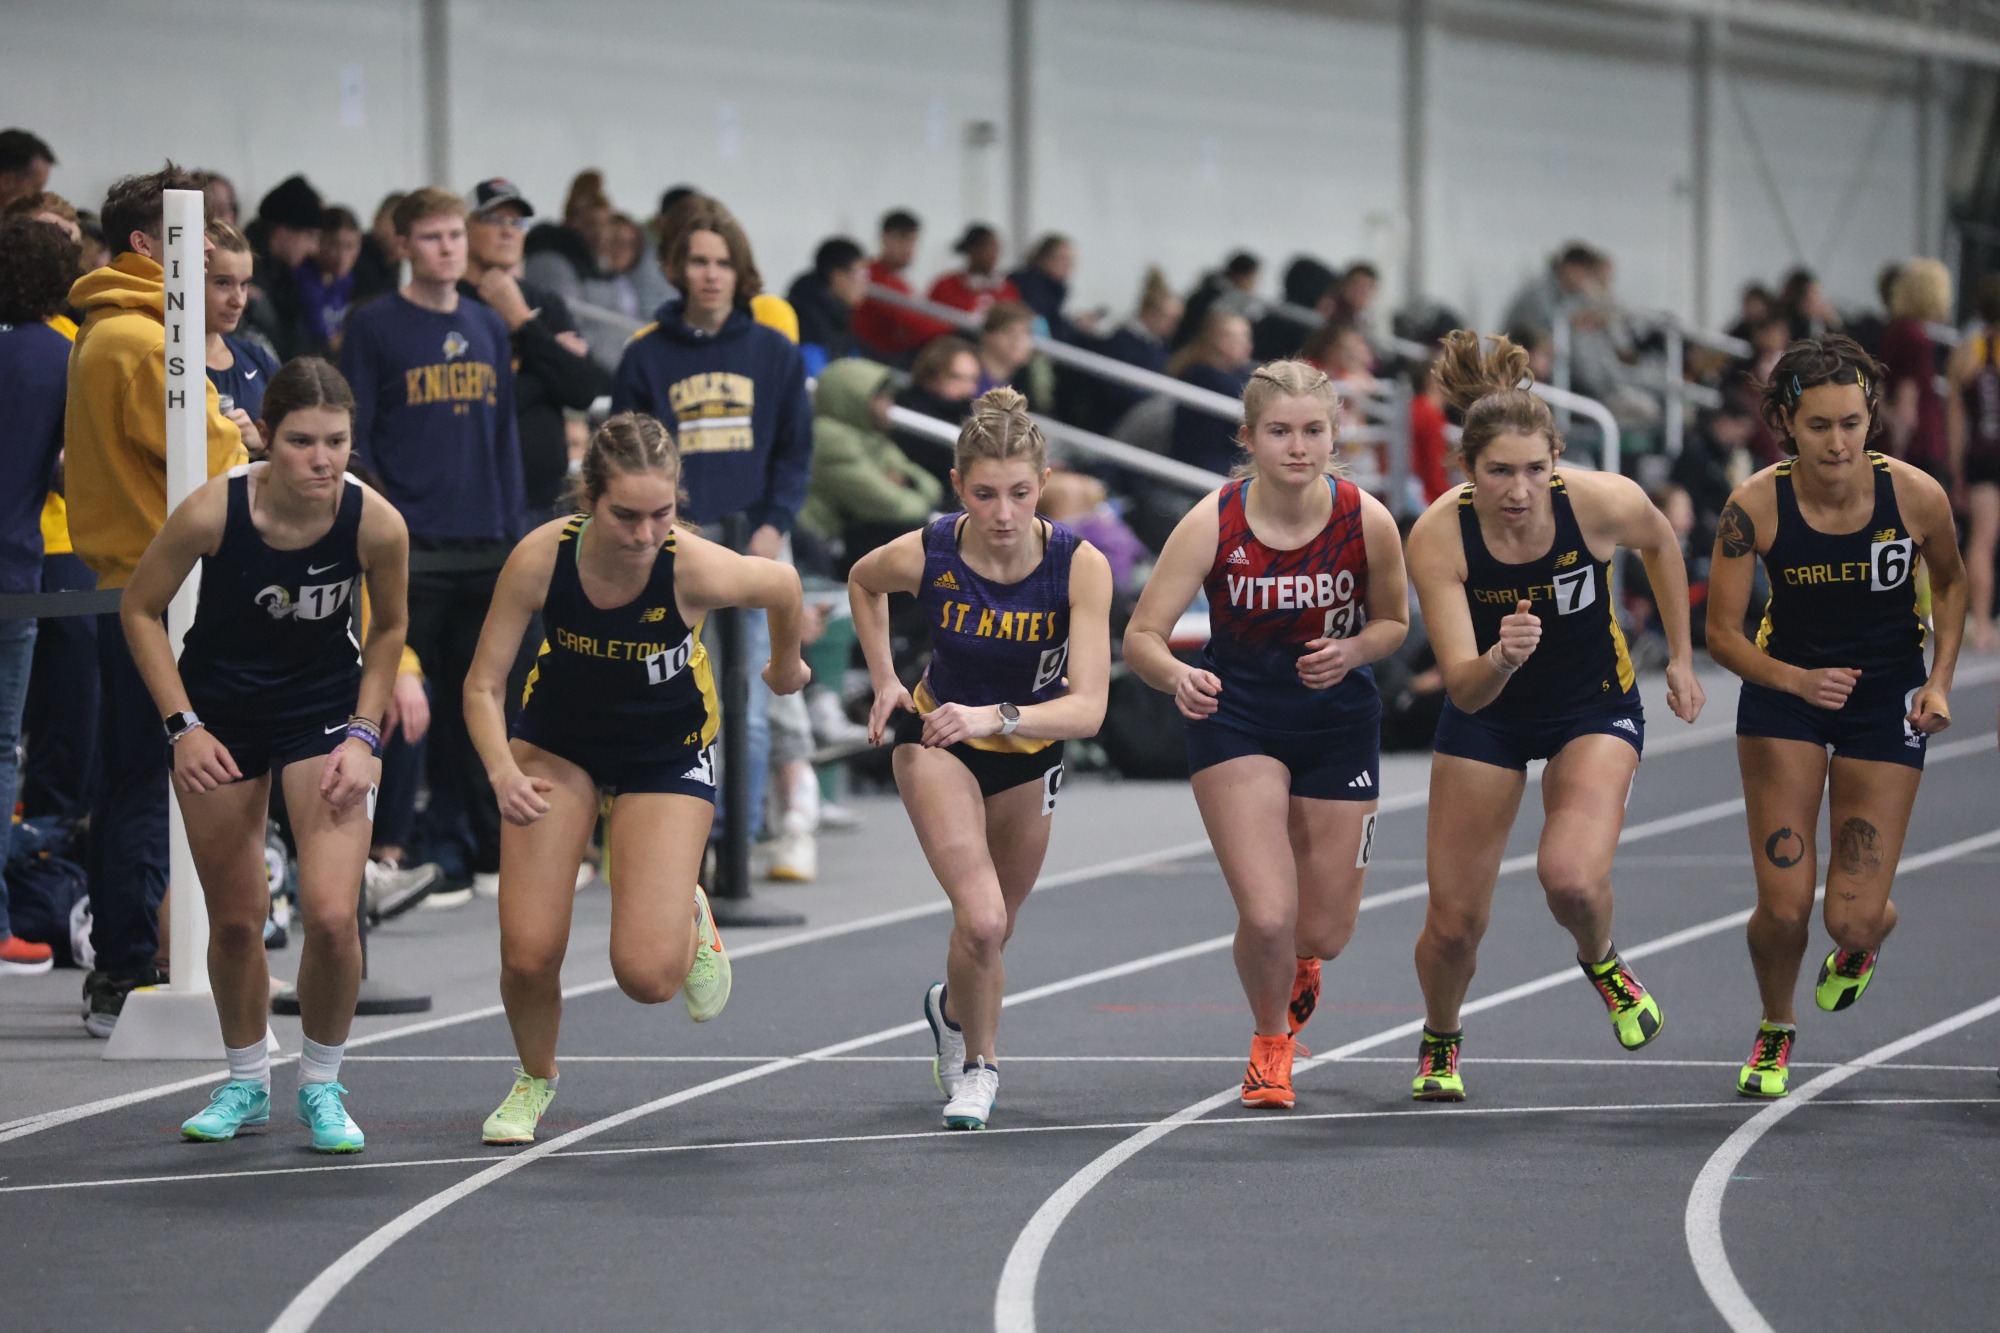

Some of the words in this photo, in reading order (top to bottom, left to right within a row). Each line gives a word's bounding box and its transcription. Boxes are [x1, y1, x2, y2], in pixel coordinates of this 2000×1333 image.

[167, 226, 186, 409] FINISH
[1226, 557, 1250, 566] adidas
[1783, 562, 1871, 585] CARLET
[1877, 543, 1907, 587] 6
[309, 583, 343, 618] 11
[933, 580, 960, 591] adidas
[1226, 569, 1355, 610] VITERBO
[1473, 584, 1556, 604] CARLET
[1558, 570, 1588, 612] 7
[1327, 607, 1350, 639] 8
[556, 627, 667, 662] CARLETON
[651, 642, 690, 682] 10
[1039, 646, 1066, 685] 9
[683, 731, 698, 746] 43
[1362, 815, 1376, 865] 8
